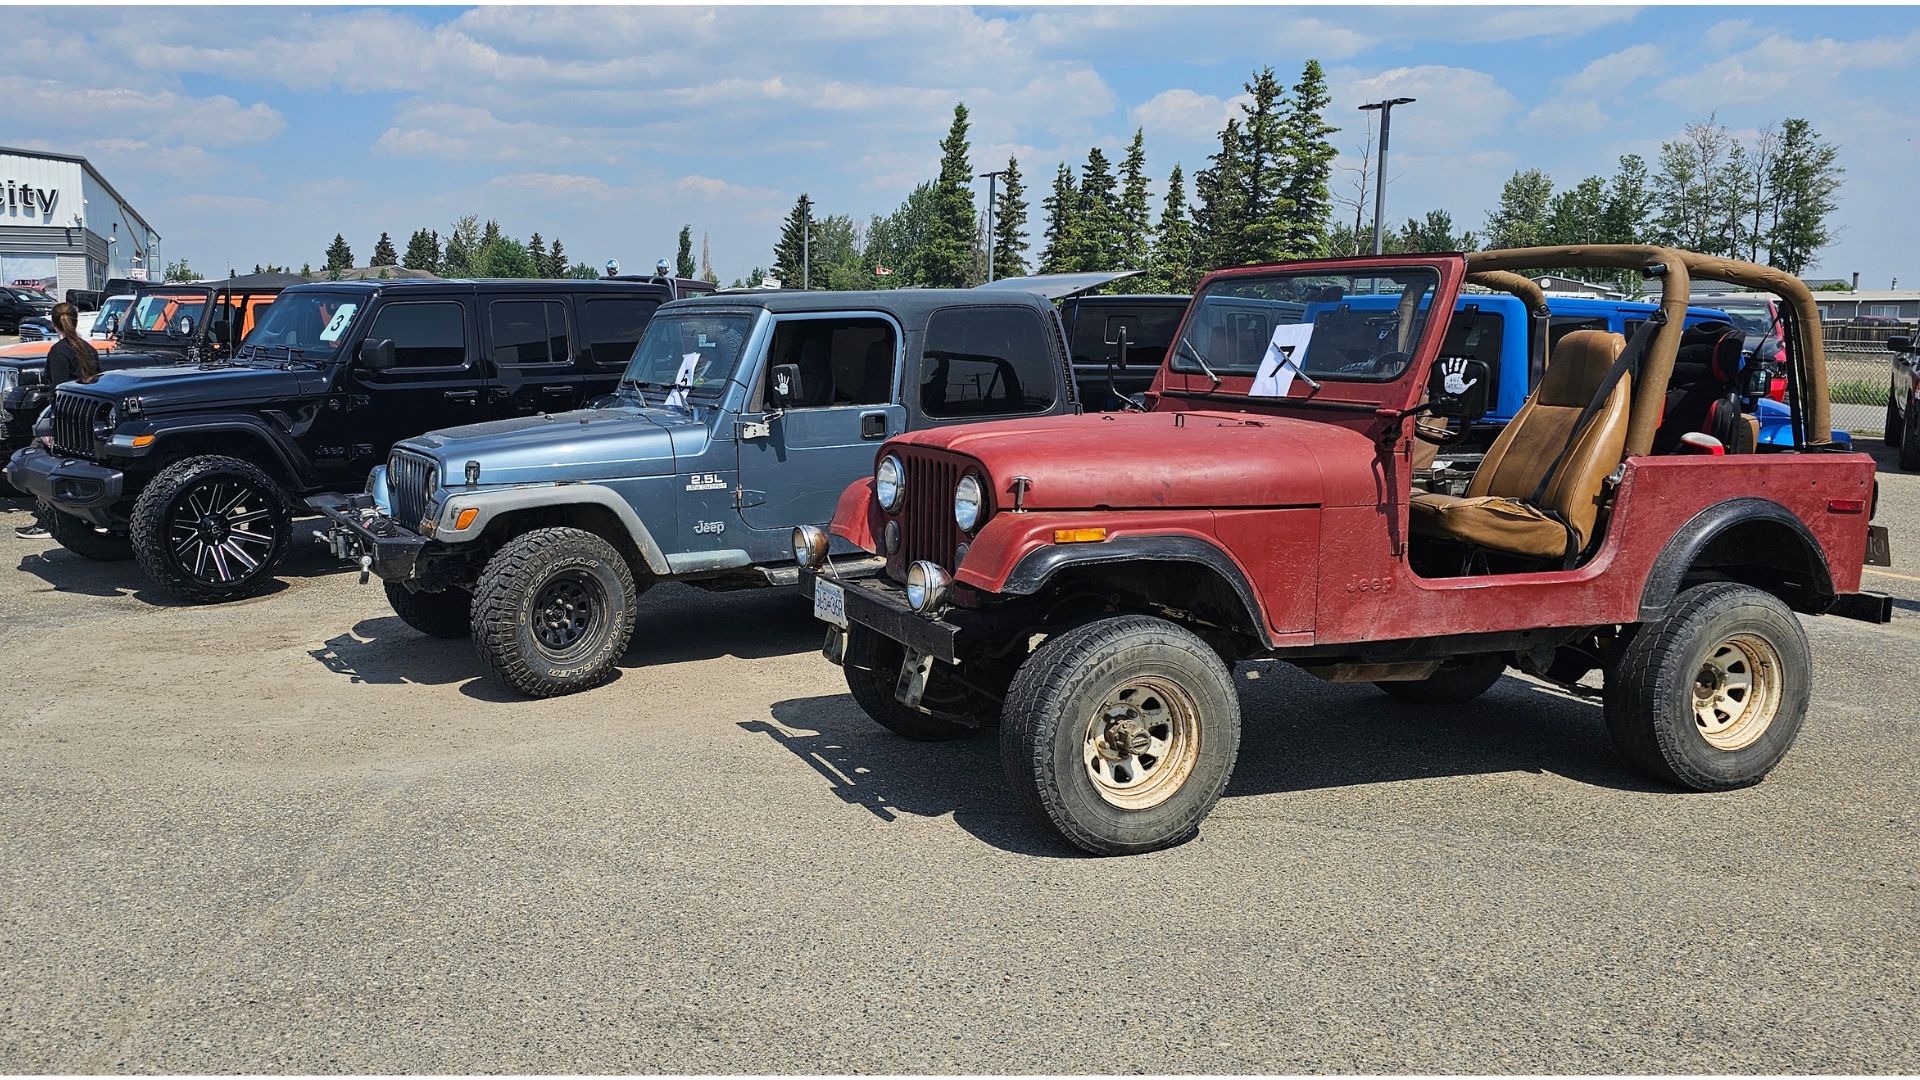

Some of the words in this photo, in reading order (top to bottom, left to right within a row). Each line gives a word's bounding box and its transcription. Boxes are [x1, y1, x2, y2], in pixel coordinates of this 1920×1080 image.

[0, 179, 58, 214] ity
[330, 314, 345, 332] 3
[1269, 345, 1296, 378] 7
[691, 474, 723, 485] 2.5L
[693, 520, 725, 534] Jeep
[520, 557, 600, 626] GOODYEAR
[1346, 574, 1393, 595] Jeep
[547, 610, 623, 678] WRANGLER
